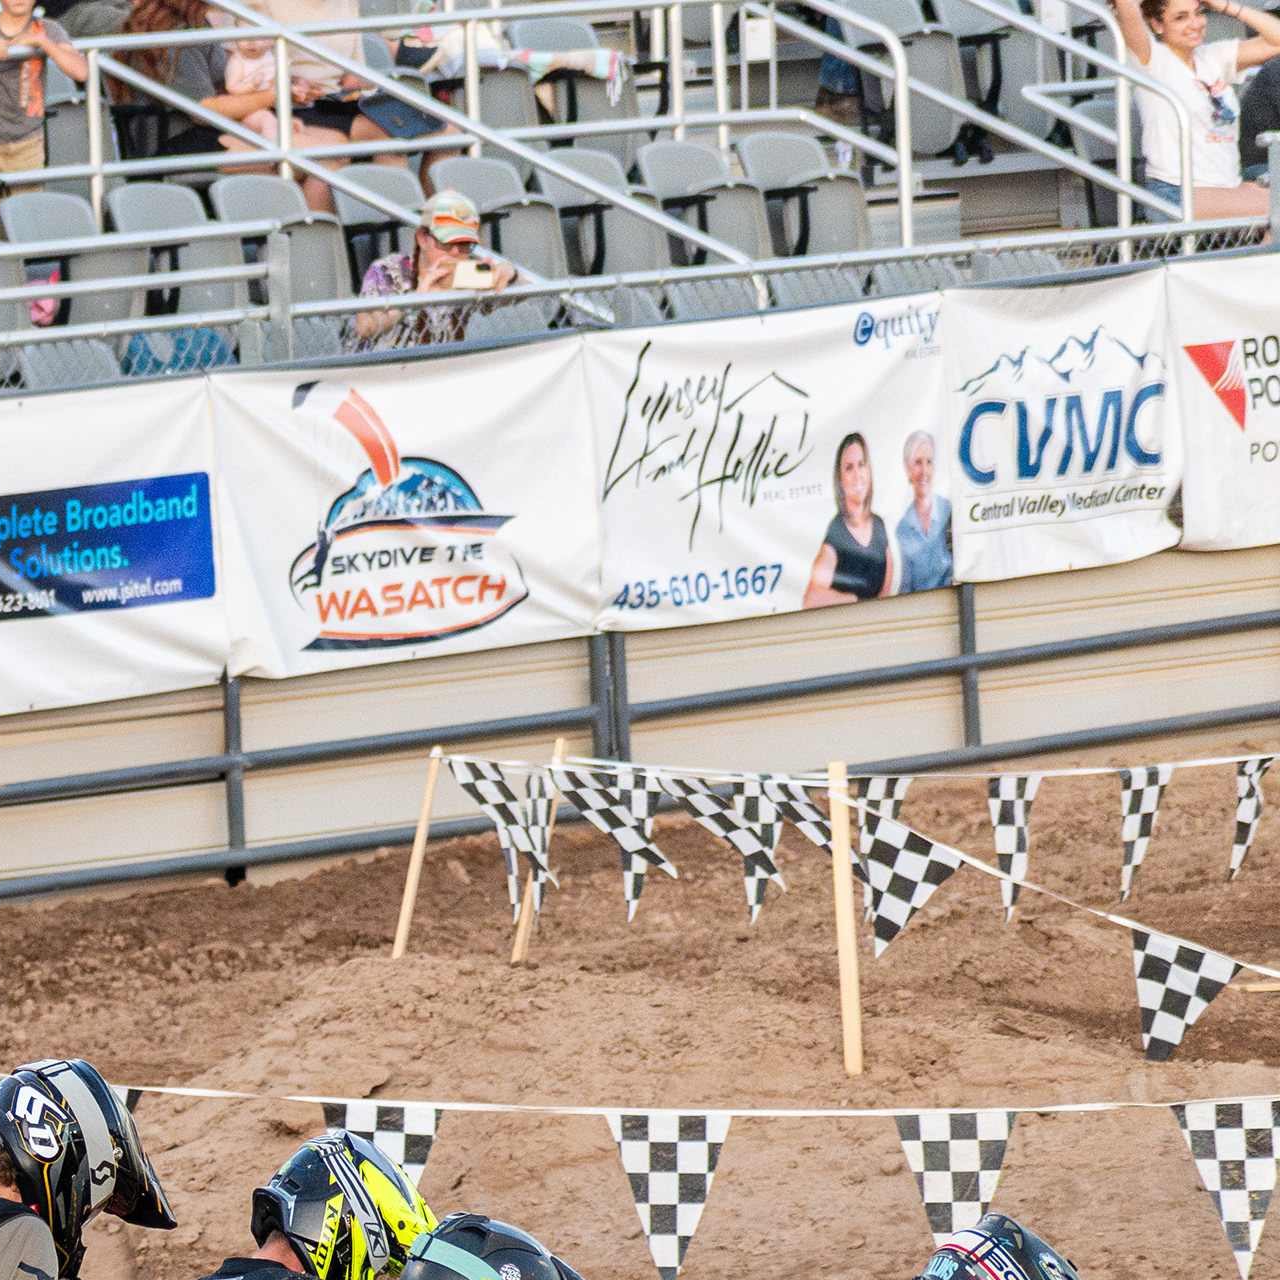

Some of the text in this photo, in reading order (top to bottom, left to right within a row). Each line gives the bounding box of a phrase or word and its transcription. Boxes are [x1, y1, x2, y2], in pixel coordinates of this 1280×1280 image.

[854, 305, 941, 349] equity
[958, 382, 1165, 486] CVMC
[66, 484, 198, 533] Broadband
[969, 496, 1016, 522] Central
[1017, 494, 1067, 517] Valley
[10, 543, 130, 580] Solutions.
[331, 546, 437, 575] SKYDIVE
[81, 577, 183, 604] www.jsitel.com
[316, 574, 507, 624] WASATCH
[612, 564, 783, 610] 435-610-1667
[316, 1203, 339, 1270] Klim
